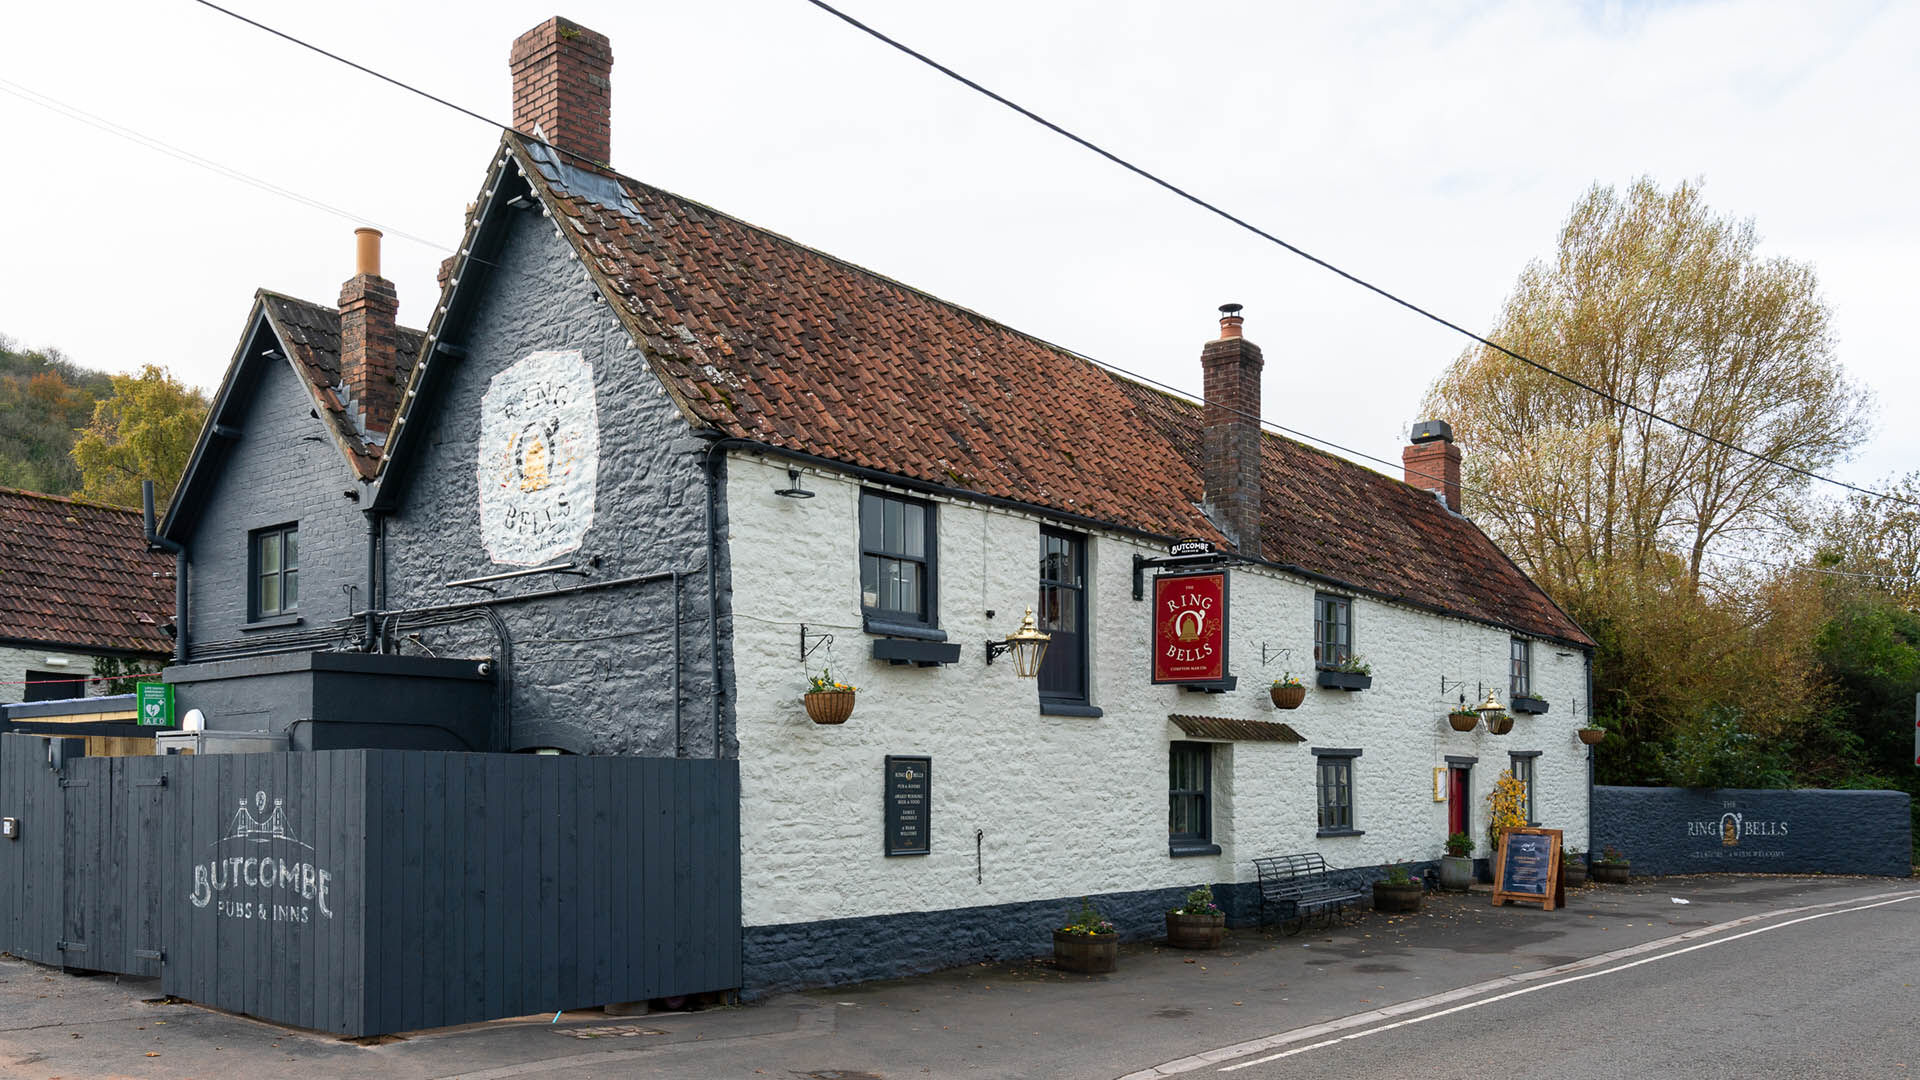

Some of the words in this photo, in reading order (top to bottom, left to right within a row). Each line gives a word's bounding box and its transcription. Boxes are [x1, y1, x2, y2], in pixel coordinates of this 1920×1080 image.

[1171, 542, 1209, 555] BUTCOMBE
[1167, 593, 1213, 613] RING
[1166, 642, 1213, 662] BELLS
[1687, 822, 1716, 836] RING
[1744, 822, 1788, 835] BELLS
[190, 857, 333, 919] BUTCOMBE
[217, 901, 252, 919] PUBS
[258, 903, 267, 920] &
[273, 904, 309, 923] INNS
